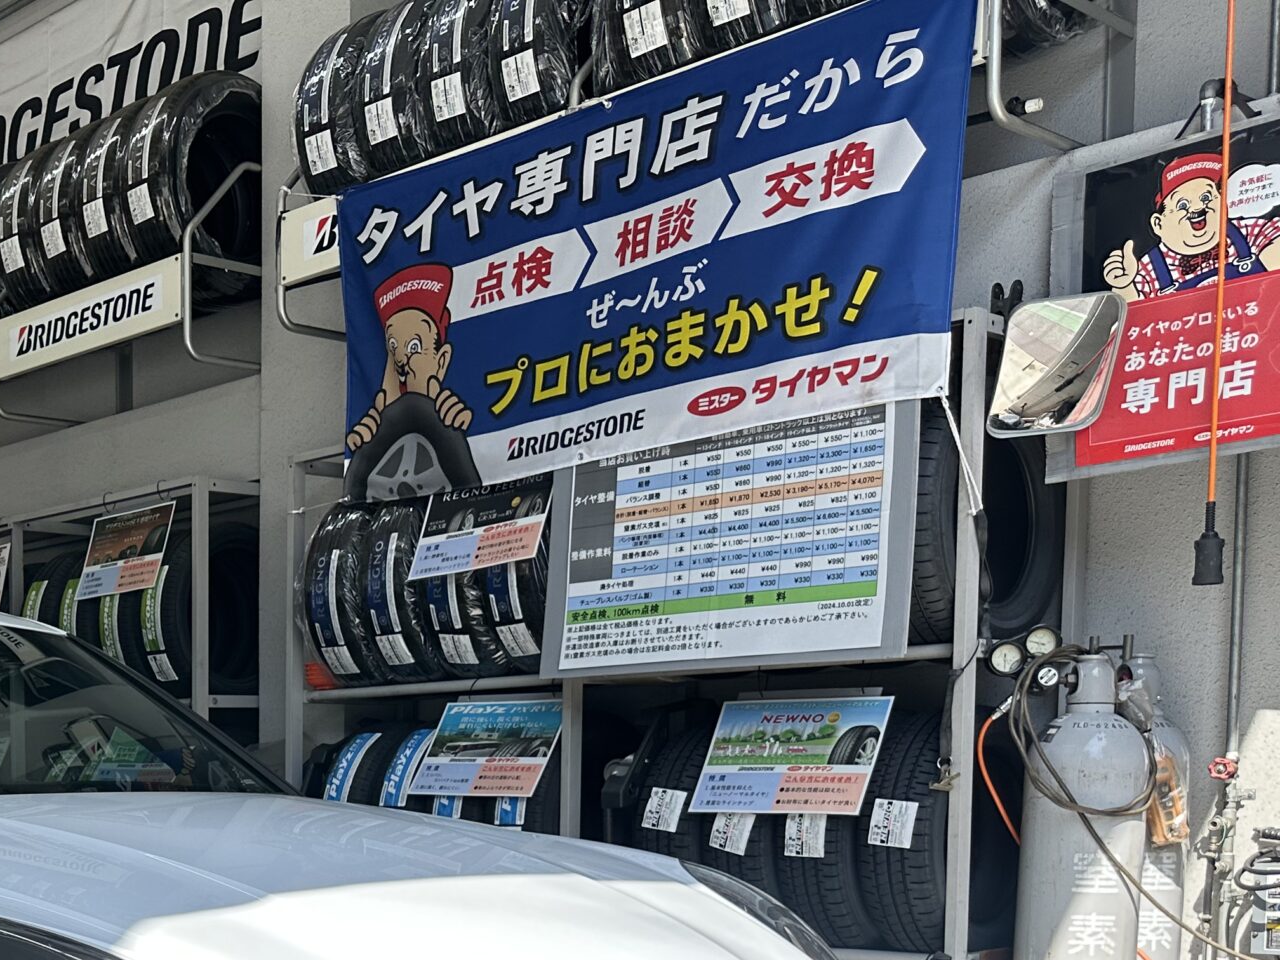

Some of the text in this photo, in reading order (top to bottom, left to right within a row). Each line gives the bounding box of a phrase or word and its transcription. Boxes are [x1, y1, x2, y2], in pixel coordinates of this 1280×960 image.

[357, 27, 923, 264] タイヤ専門店 だから
[1167, 160, 1223, 183] BRIDGESTONE
[470, 141, 876, 307] 点検 相談 交換
[379, 279, 444, 309] BRIDGESTONE
[16, 281, 156, 358] BRIDGESTONE
[1124, 330, 1259, 372] あなたの街の
[1121, 360, 1257, 414] 専門店
[507, 354, 889, 461] BRIDGESTONE ミスター タイヤマン
[1124, 438, 1176, 453] BRIDGESTONE
[443, 487, 491, 502] REGNO
[575, 490, 616, 507] タイヤ整備
[760, 714, 825, 724] NEWNO
